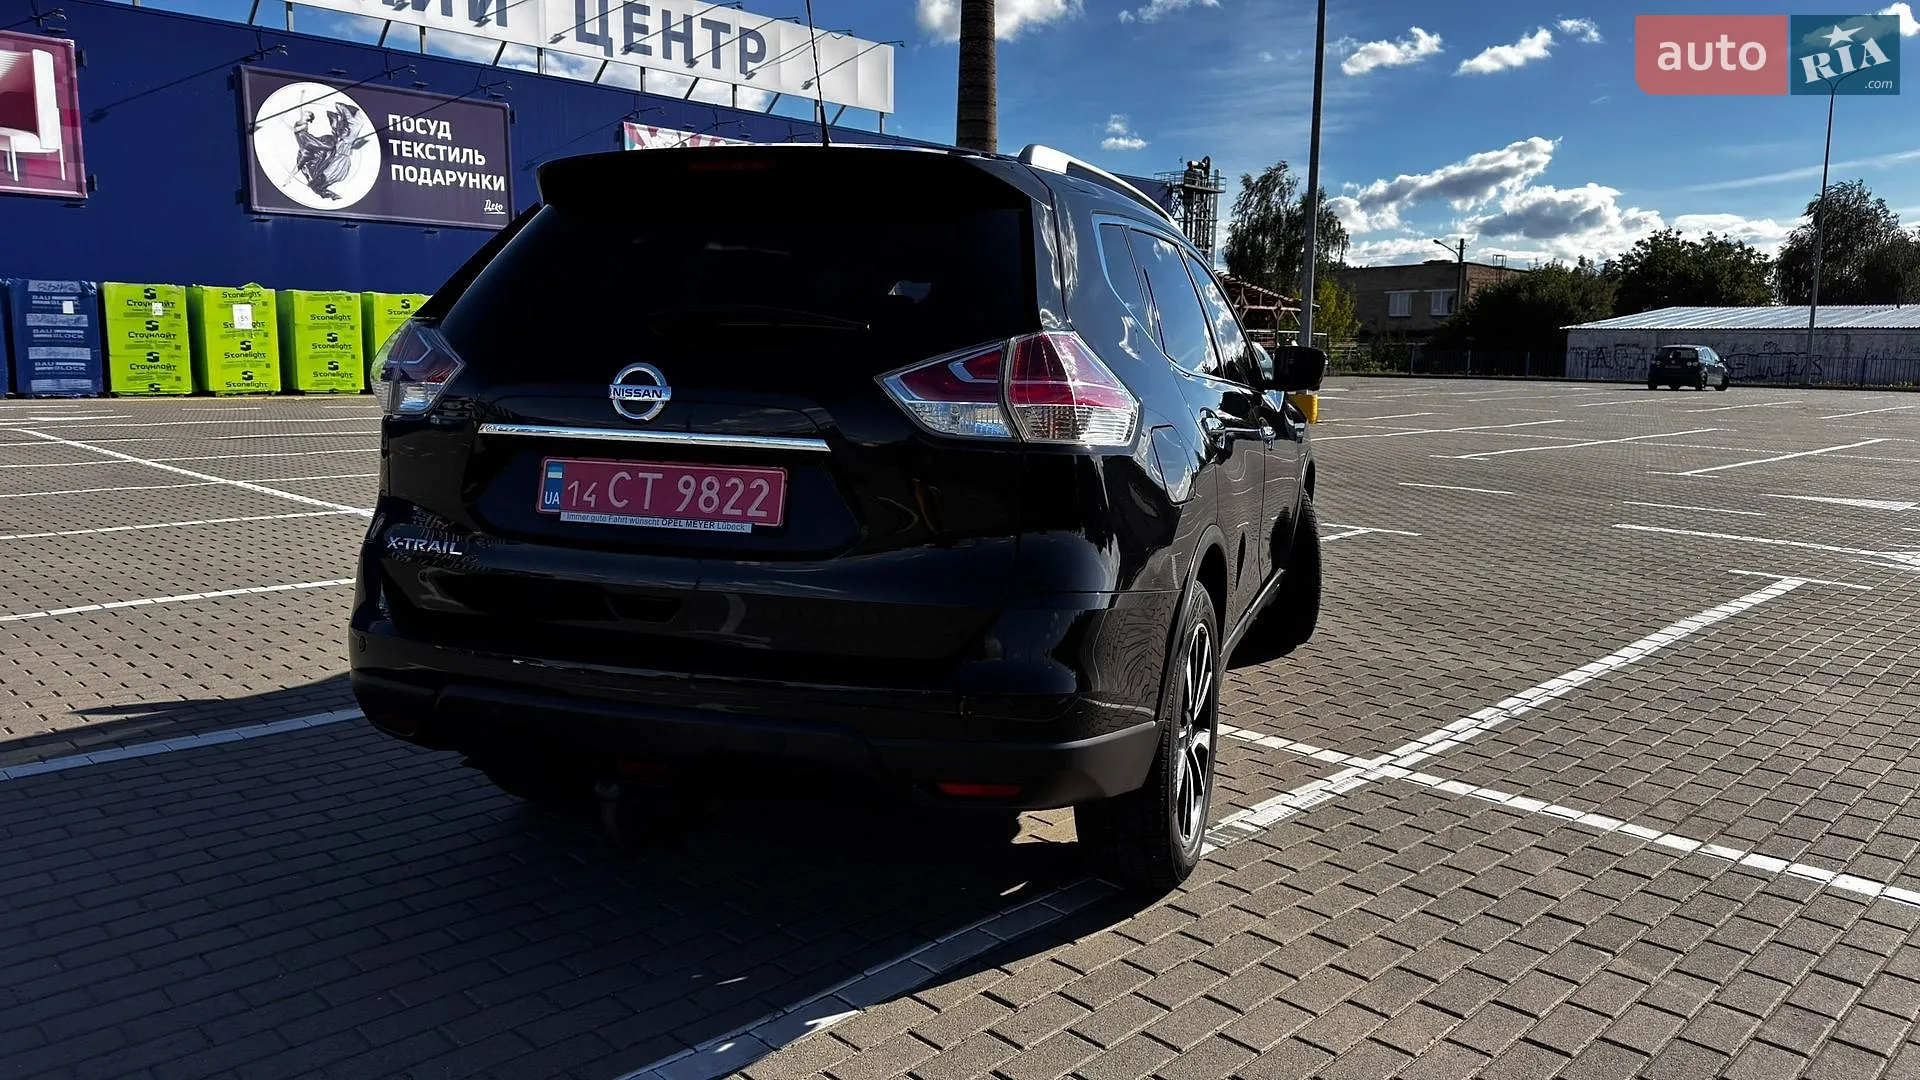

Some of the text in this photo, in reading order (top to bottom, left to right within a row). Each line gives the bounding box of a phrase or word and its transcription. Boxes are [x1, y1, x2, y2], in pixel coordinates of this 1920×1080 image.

[574, 0, 767, 76] ЦЕНТР
[388, 114, 452, 140] ПОСУД
[388, 139, 486, 166] ТЕКСТИЛЬ
[391, 164, 505, 191] ПОДАРУНКИ
[310, 313, 352, 321] Stonelight
[311, 342, 353, 350] Stonelight
[613, 387, 662, 399] NISSAN
[544, 490, 561, 505] UA
[567, 471, 770, 517] 14 CT 9822
[661, 519, 684, 527] OPEL
[686, 520, 715, 529] MEYER
[387, 536, 462, 555] X-TRAIL
